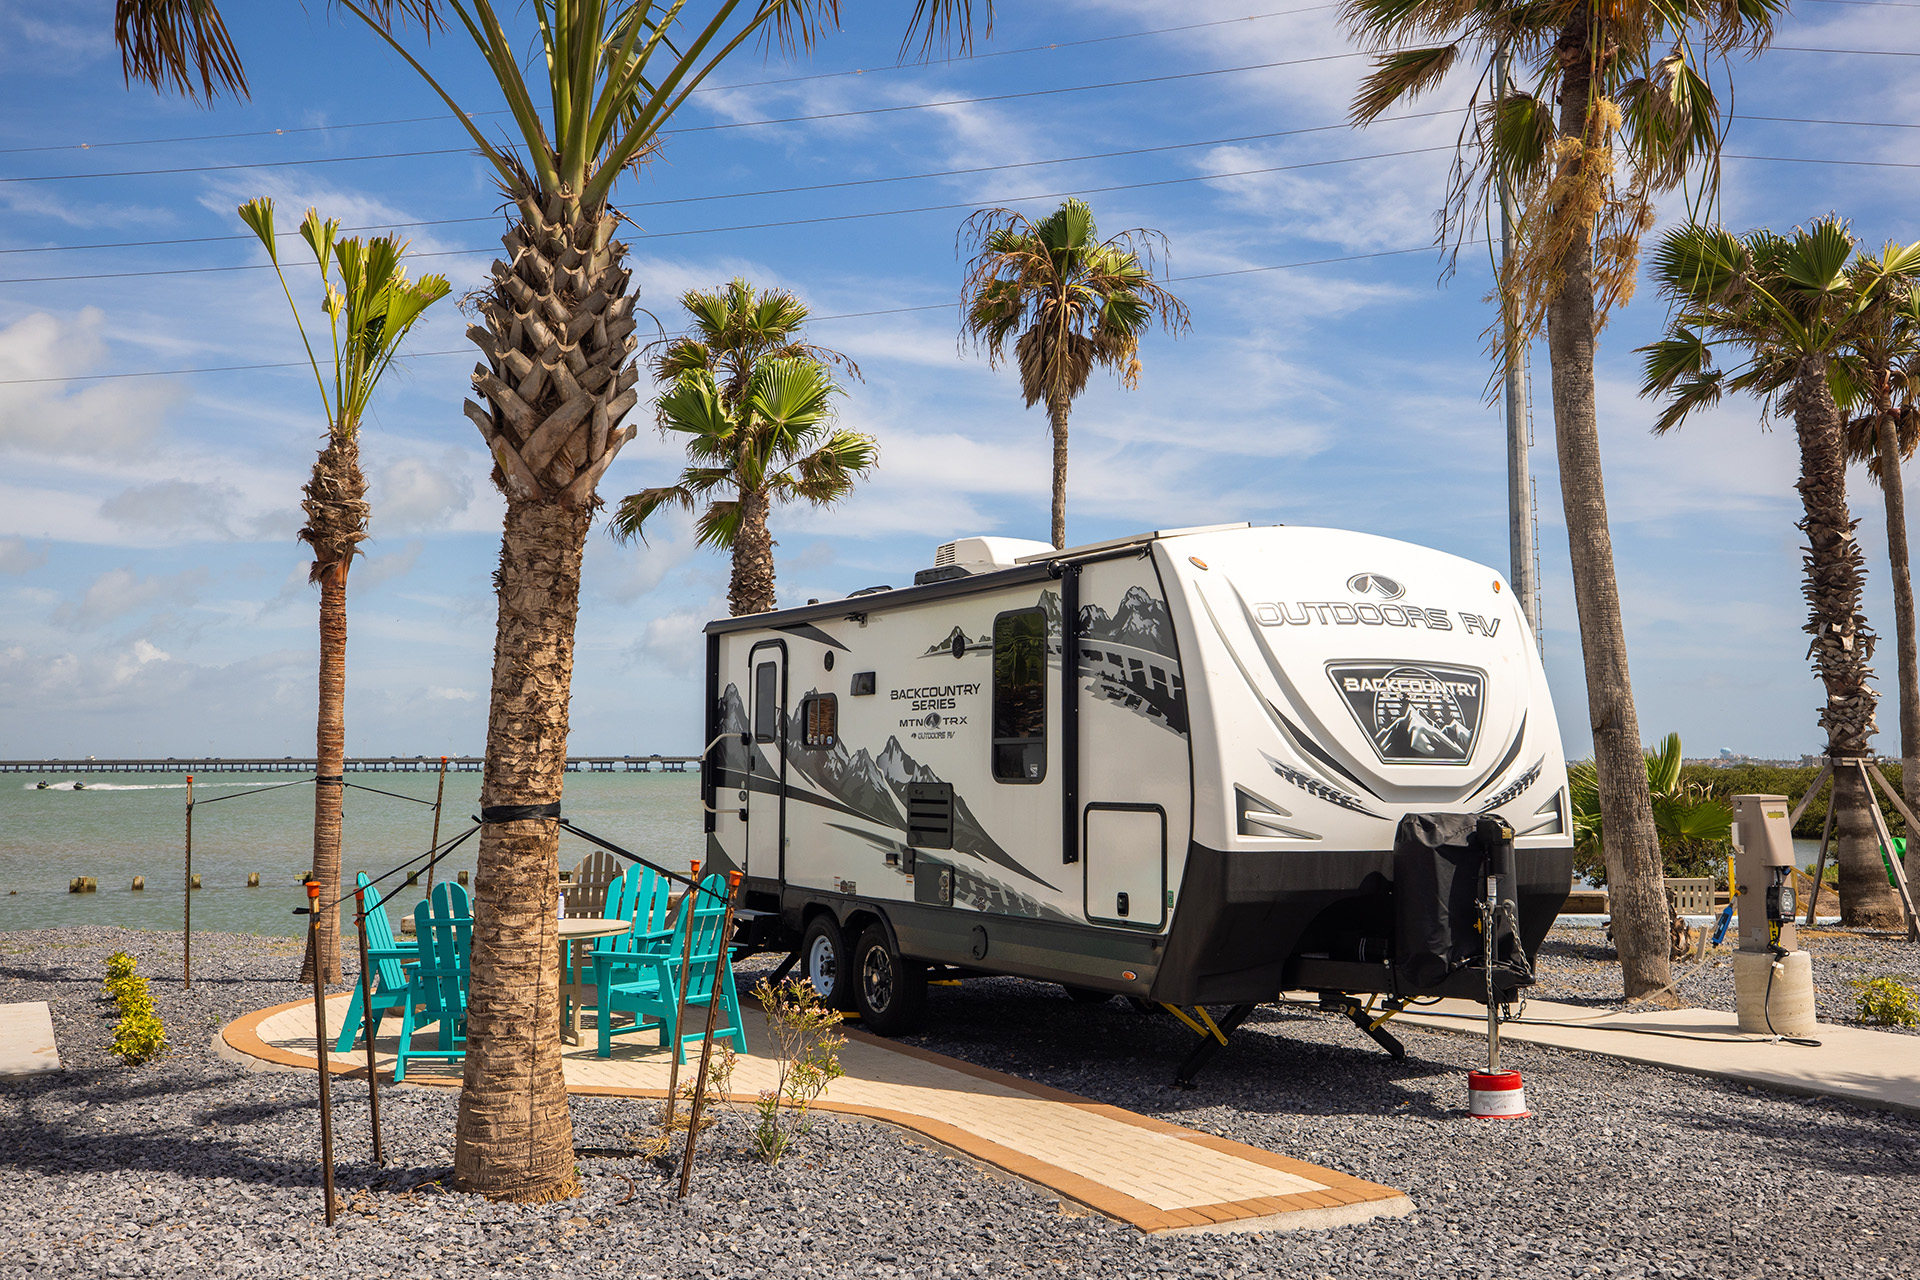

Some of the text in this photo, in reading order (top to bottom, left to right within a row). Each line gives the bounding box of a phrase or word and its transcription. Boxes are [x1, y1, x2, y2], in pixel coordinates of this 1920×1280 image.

[1252, 602, 1500, 638] OUTDOORS RV
[890, 683, 981, 700] BACKCOUNTRY
[1343, 677, 1477, 697] BACKCOUNTRY
[911, 698, 956, 711] SERIES
[899, 716, 968, 727] MTN TRX
[917, 731, 956, 740] OUTDOORS RV
